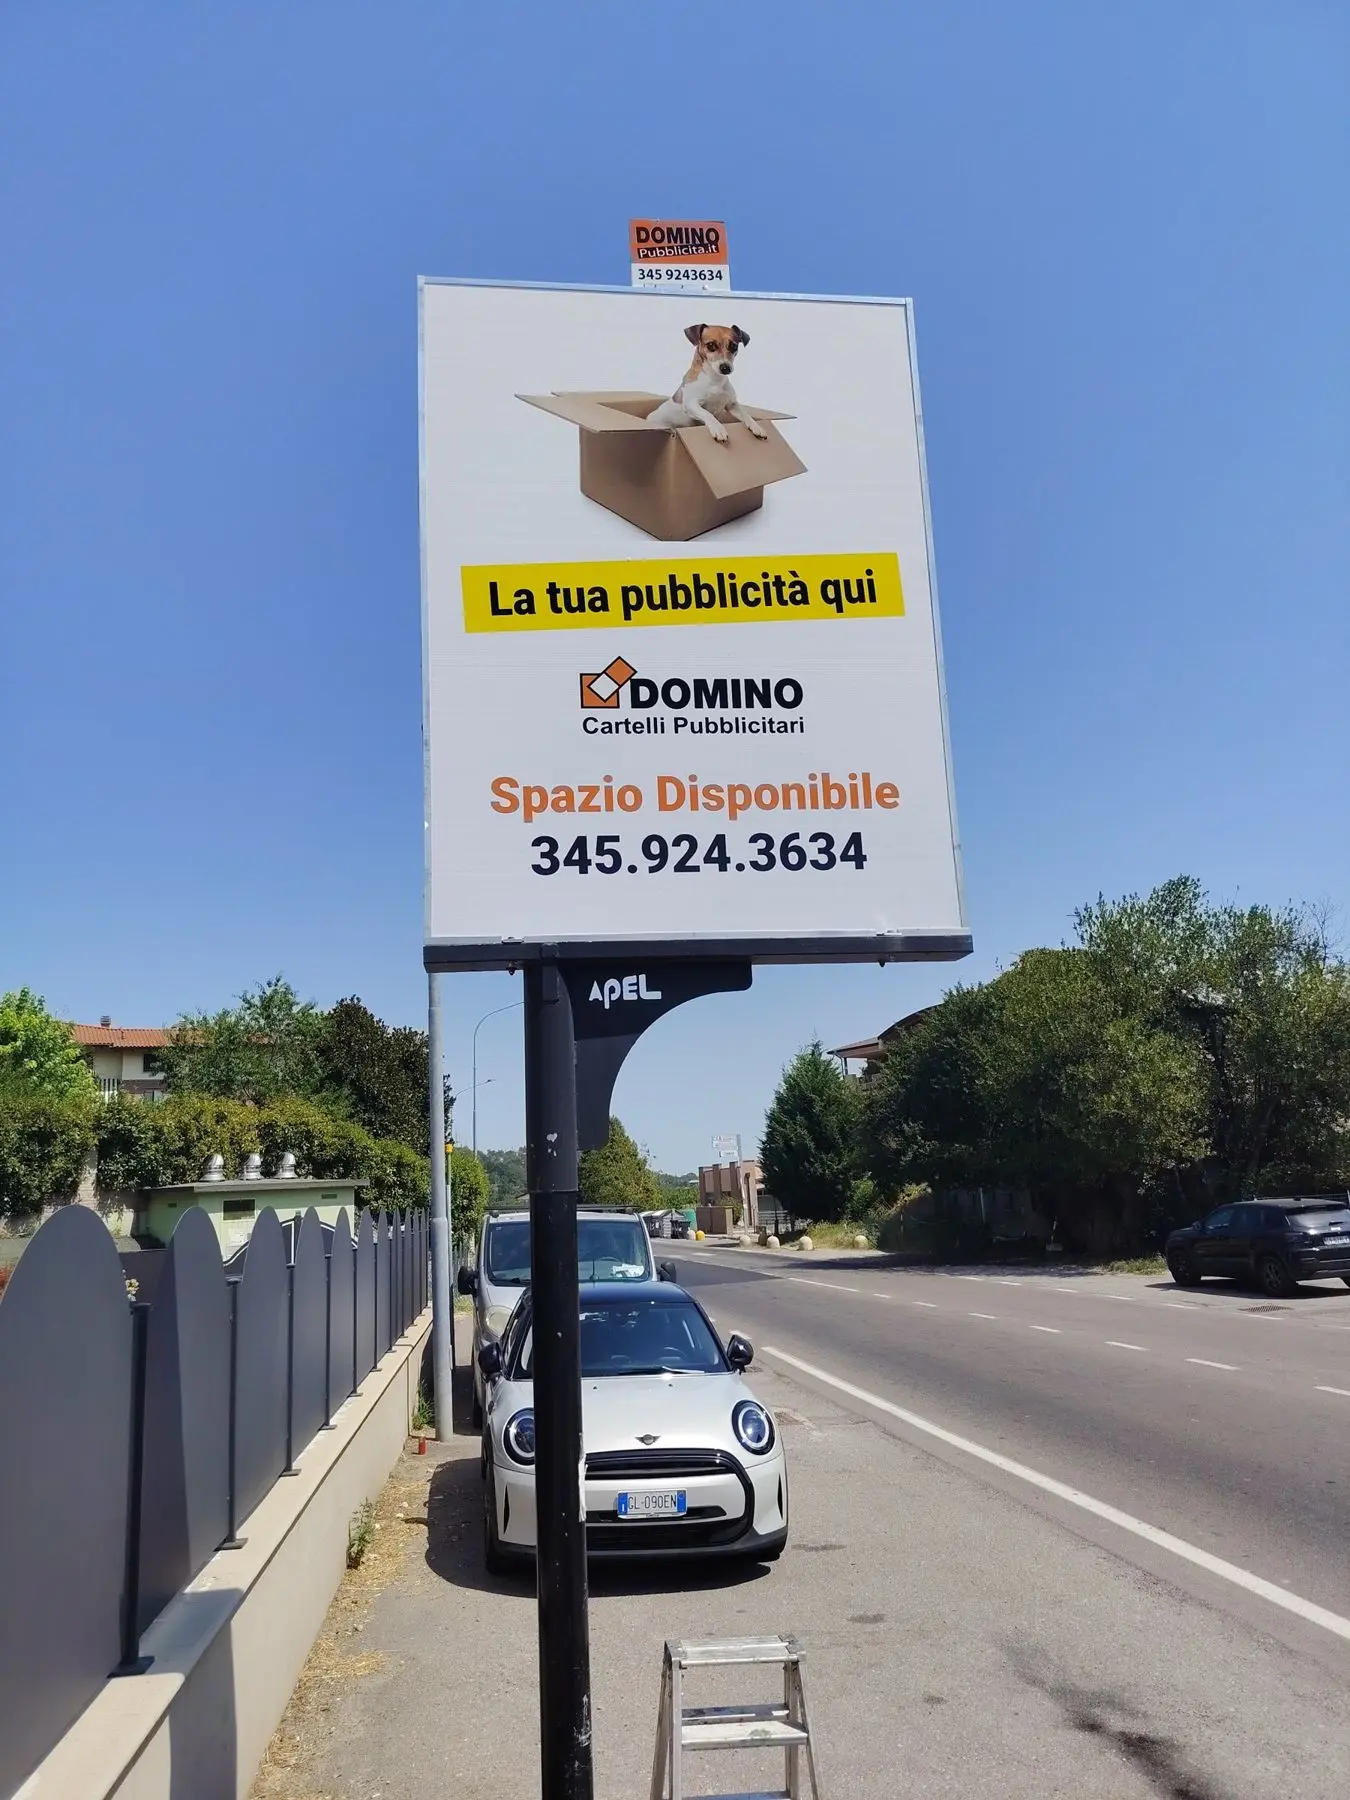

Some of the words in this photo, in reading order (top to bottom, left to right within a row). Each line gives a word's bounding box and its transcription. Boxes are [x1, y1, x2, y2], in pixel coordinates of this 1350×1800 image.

[635, 226, 720, 244] DOMINO
[639, 244, 718, 258] Pubblicita.it
[638, 268, 662, 280] 345
[665, 269, 723, 281] 9243634
[489, 582, 537, 616] La
[546, 582, 610, 614] tua
[621, 570, 810, 622] pubblicità
[820, 569, 877, 614] qui
[630, 677, 804, 710] DOMINO
[582, 716, 666, 735] Cartelli
[673, 716, 805, 735] Pubblicitari
[490, 776, 643, 822] Spazio
[657, 772, 899, 820] Disponibile
[530, 831, 868, 876] 345.924.3634
